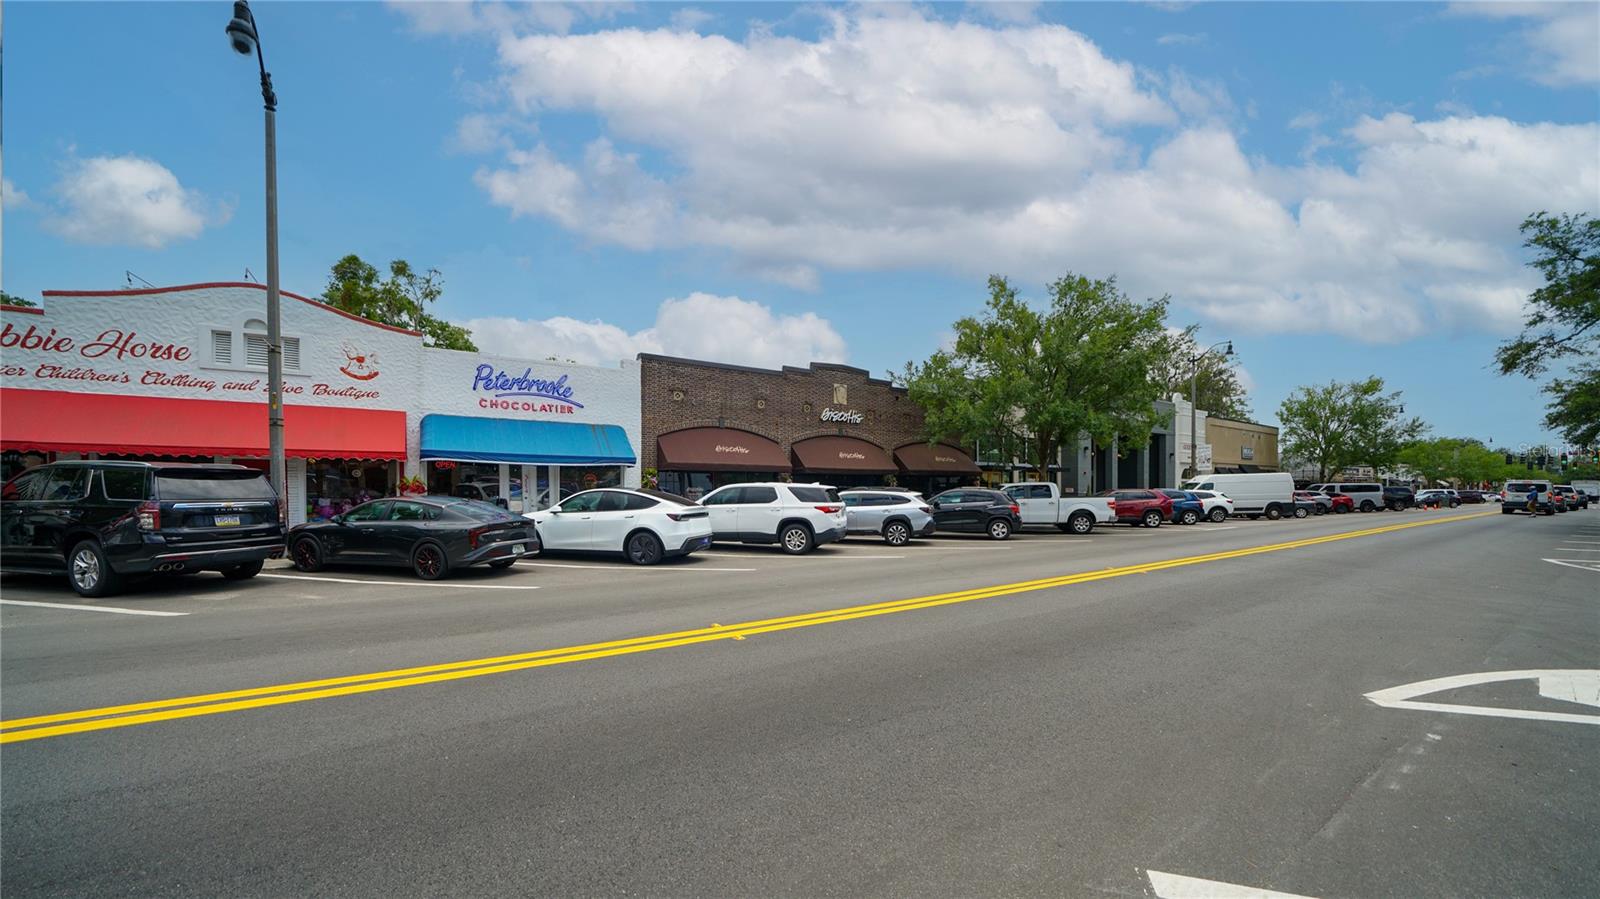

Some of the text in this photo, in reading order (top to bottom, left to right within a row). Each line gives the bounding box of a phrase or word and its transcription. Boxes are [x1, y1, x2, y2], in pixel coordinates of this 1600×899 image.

[80, 329, 192, 361] Horse
[35, 363, 131, 384] Children's
[140, 370, 216, 392] Clothing
[222, 379, 260, 391] and
[263, 381, 304, 394] Soe
[312, 383, 380, 400] Boutique
[472, 363, 574, 398] Peterbrooke
[478, 398, 574, 414] CHOCOLATIER
[435, 461, 456, 470] OPEN
